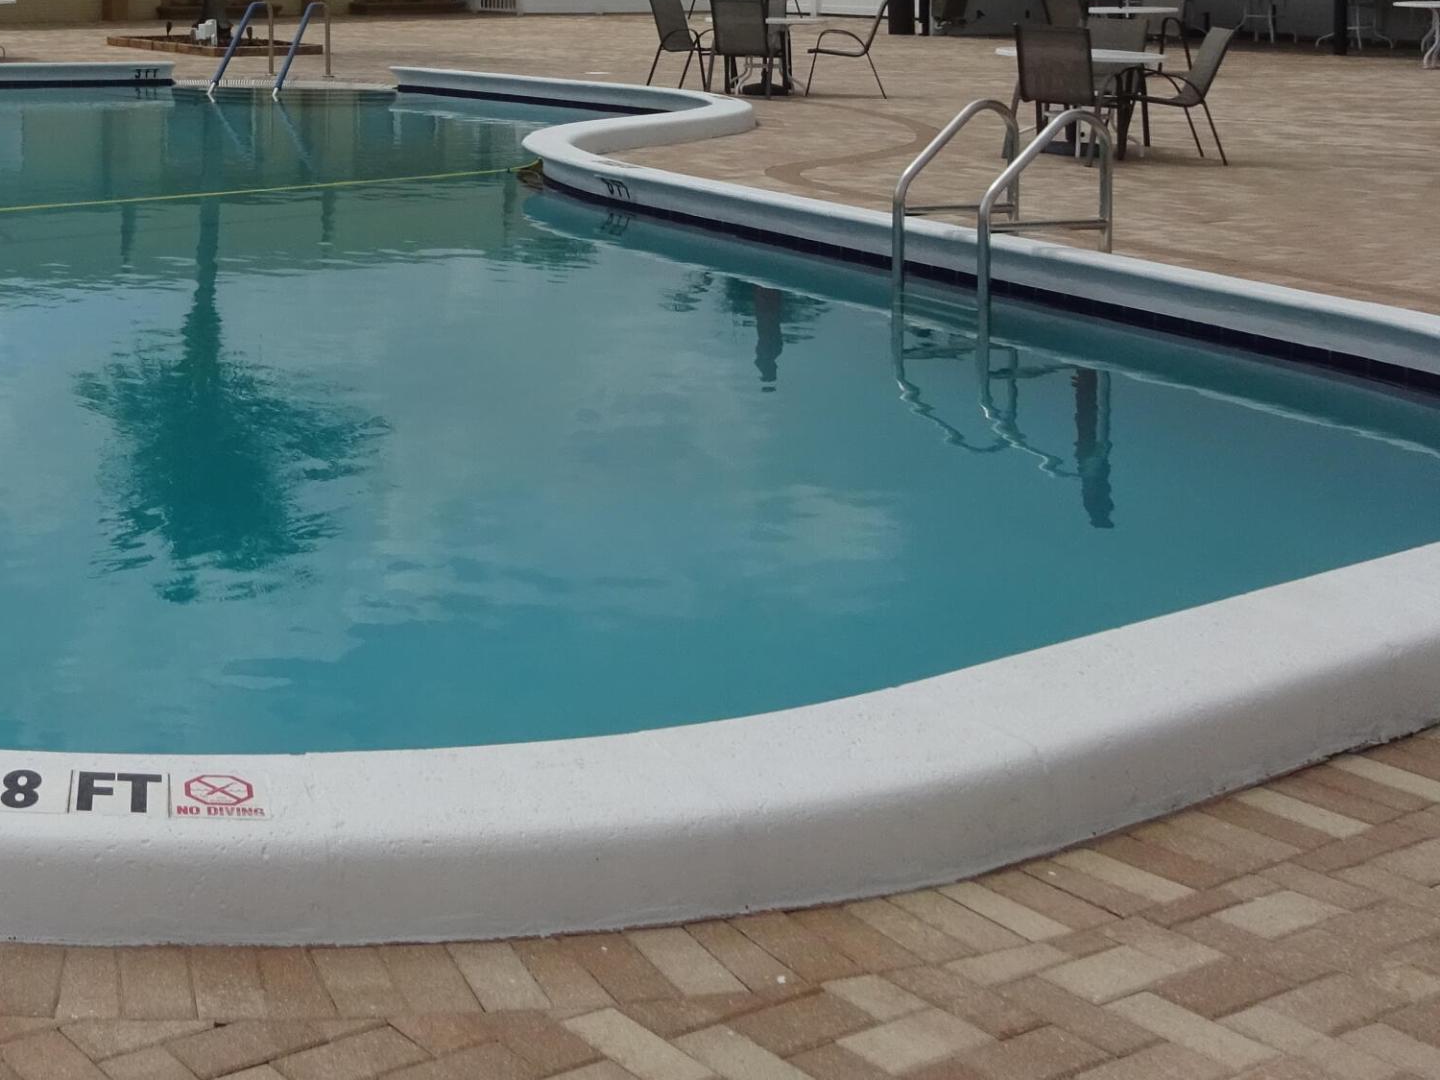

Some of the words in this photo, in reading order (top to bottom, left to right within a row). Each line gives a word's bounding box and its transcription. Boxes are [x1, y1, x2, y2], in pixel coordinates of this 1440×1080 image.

[0, 769, 42, 809] 8
[76, 771, 162, 813] FT
[176, 805, 200, 815] NO
[207, 806, 265, 817] DIVING
